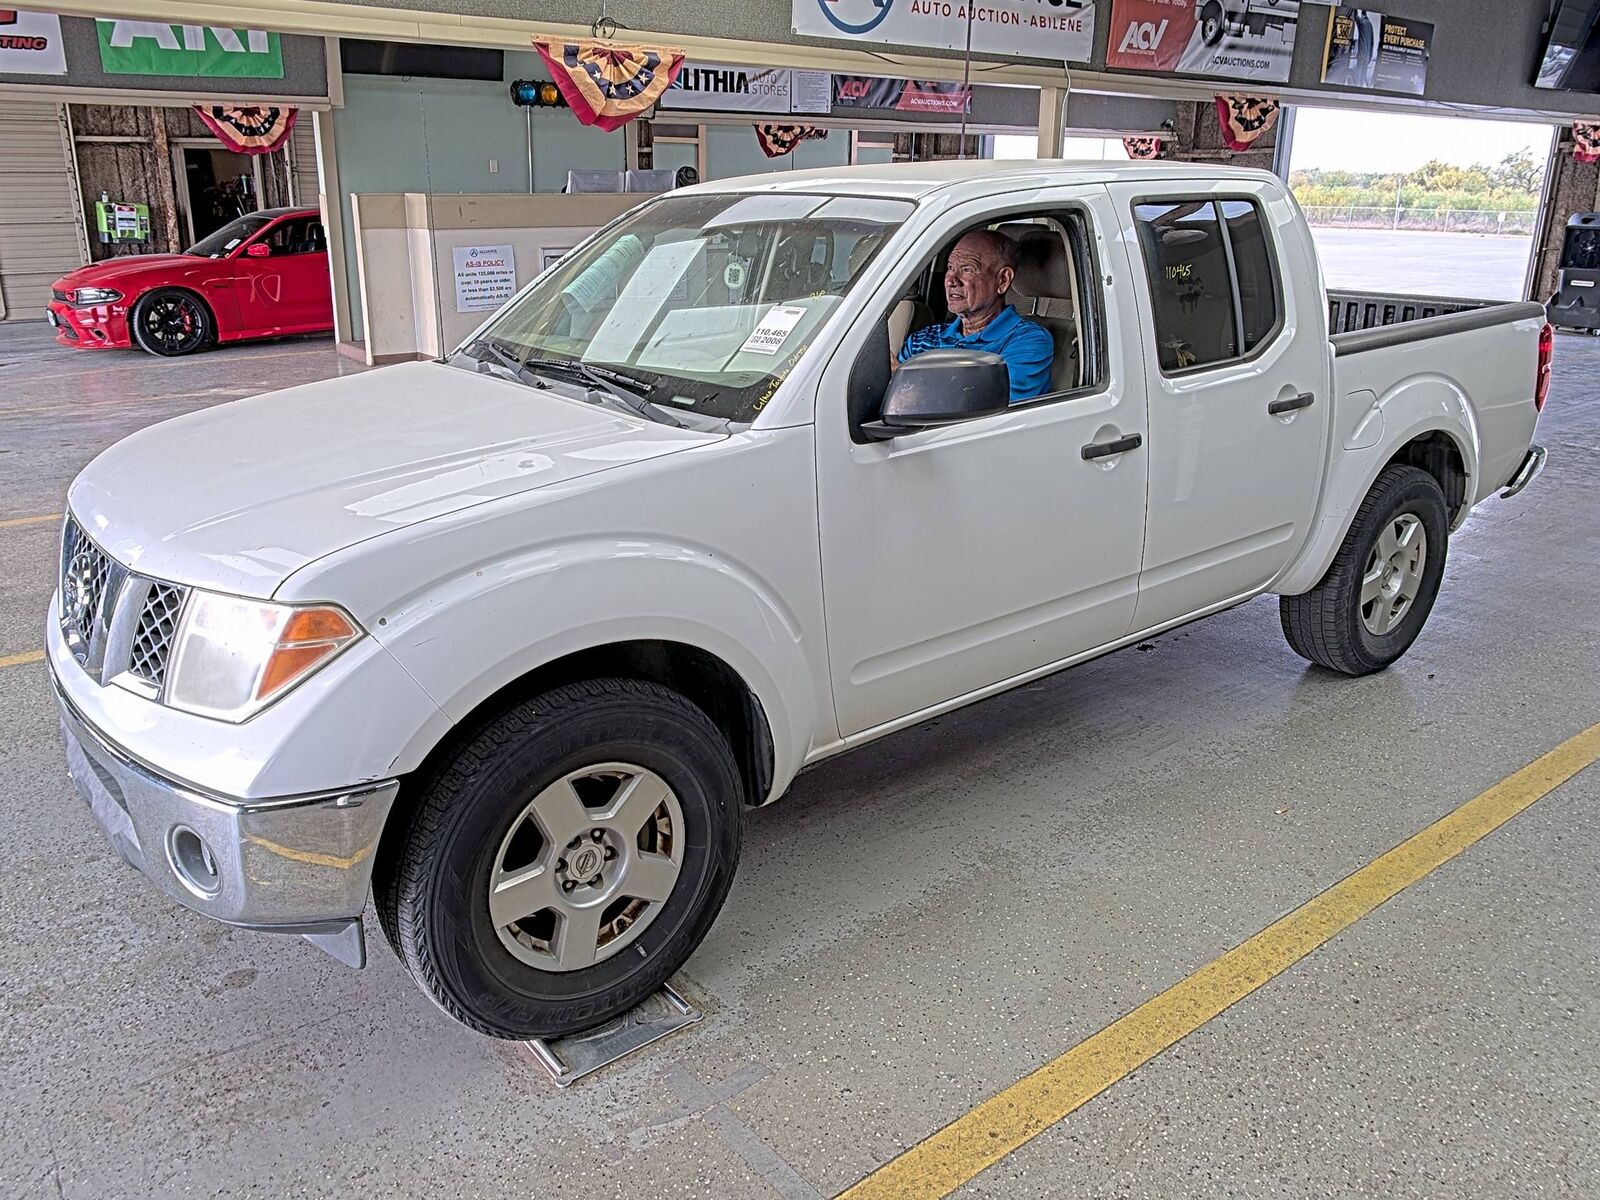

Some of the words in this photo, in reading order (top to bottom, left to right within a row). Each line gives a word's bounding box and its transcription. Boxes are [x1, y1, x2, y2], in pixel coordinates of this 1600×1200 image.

[911, 0, 951, 17] AUTO
[958, 5, 1019, 25] AUCTION
[1030, 14, 1082, 33] ABILENE
[1118, 19, 1169, 52] ACV
[1384, 23, 1408, 36] PROTECT
[1383, 34, 1400, 45] EVERY
[683, 67, 749, 94] LITHIA
[752, 73, 777, 84] AUTO
[751, 83, 788, 96] STORES
[839, 79, 872, 98] ACV
[483, 259, 504, 267] POLICY
[1165, 264, 1192, 279] 110465
[755, 328, 788, 337] 110,465
